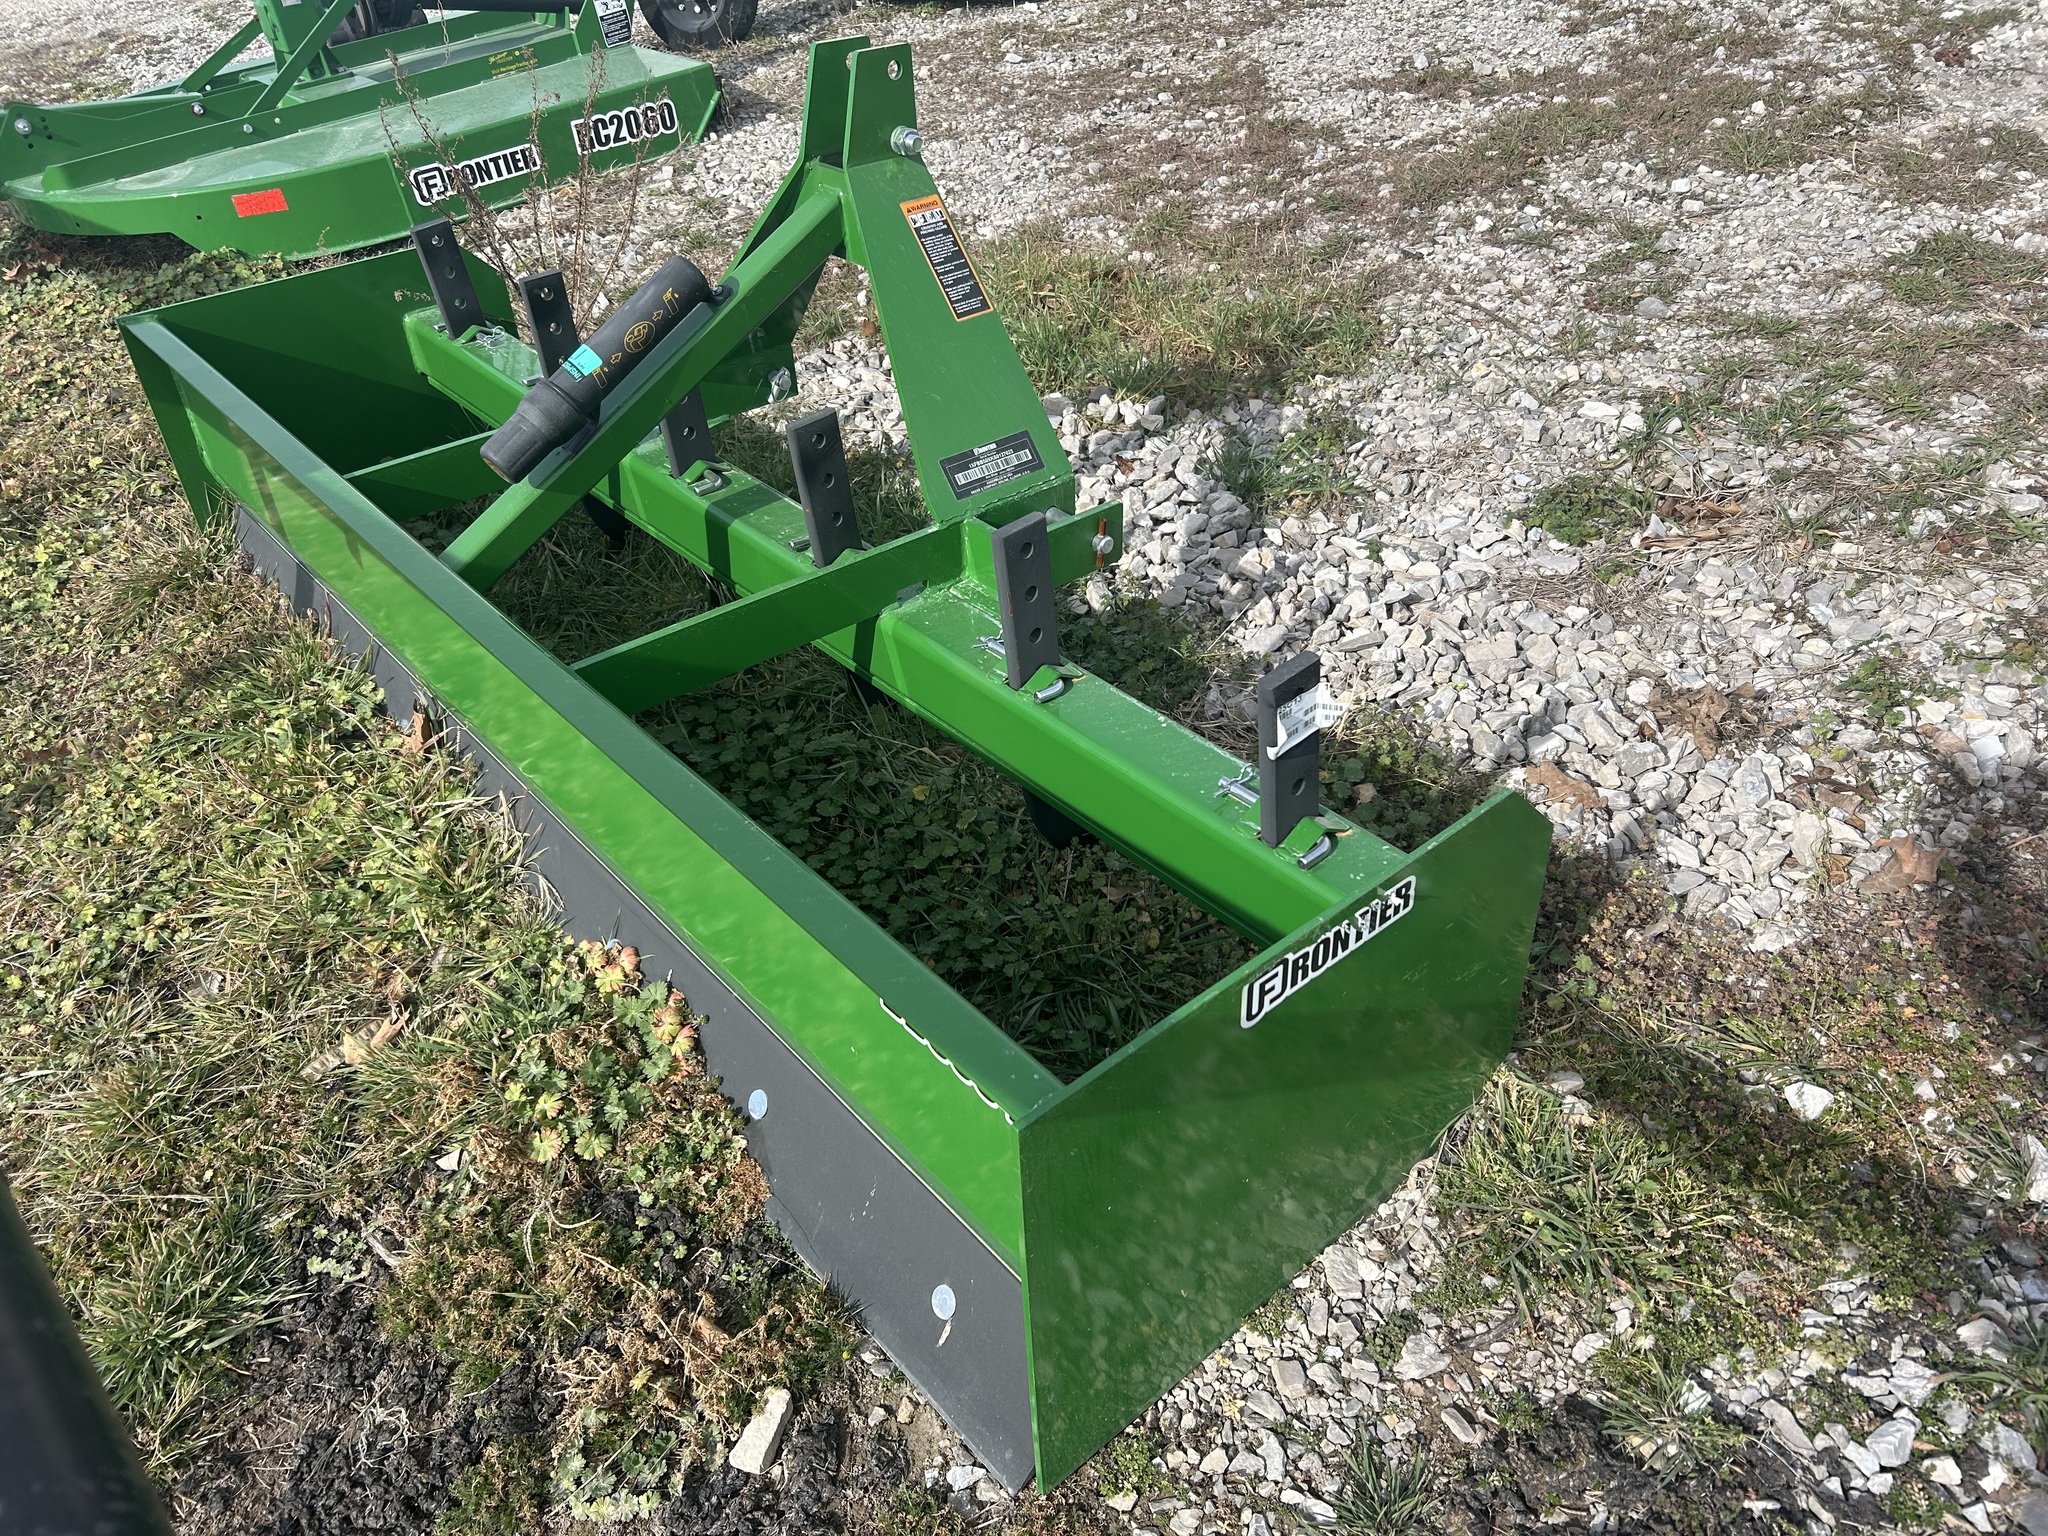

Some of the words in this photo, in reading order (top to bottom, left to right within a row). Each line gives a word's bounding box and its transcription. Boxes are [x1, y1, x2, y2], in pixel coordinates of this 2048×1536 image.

[412, 146, 538, 203] FONTIER
[911, 200, 939, 212] WARNING
[1246, 880, 1412, 1022] FRONTIER
